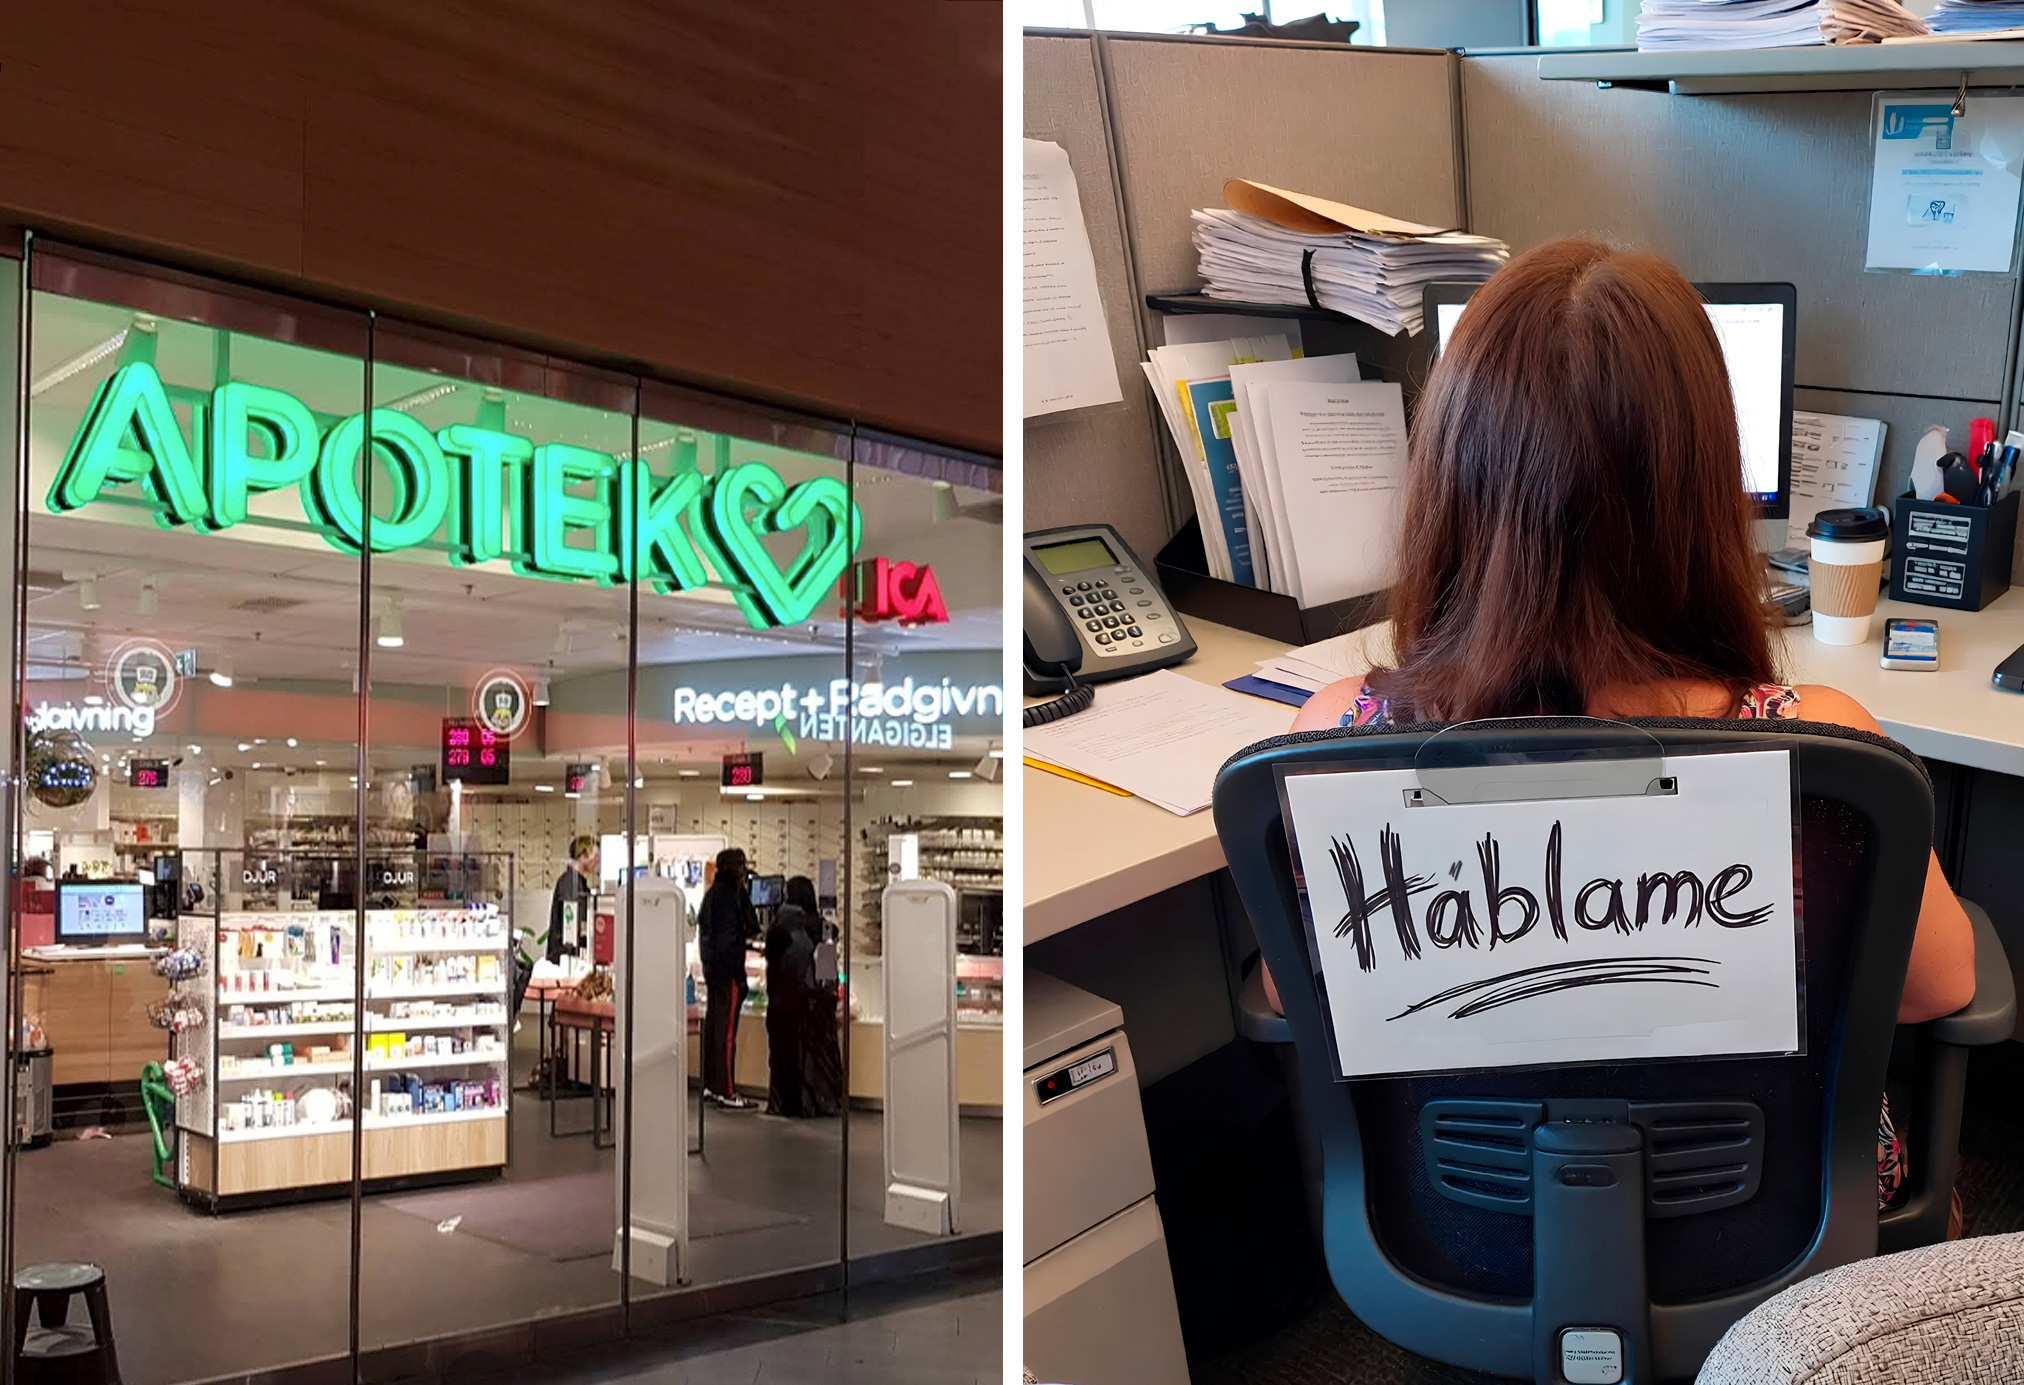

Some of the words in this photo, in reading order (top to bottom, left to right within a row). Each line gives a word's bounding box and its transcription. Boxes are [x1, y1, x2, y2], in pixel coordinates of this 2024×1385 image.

[46, 361, 708, 593] APOTEK
[873, 557, 950, 622] ICA
[674, 683, 797, 726] Recept
[243, 870, 277, 884] DJUR
[383, 871, 414, 885] DJUR
[1329, 820, 1774, 973] Háblame
